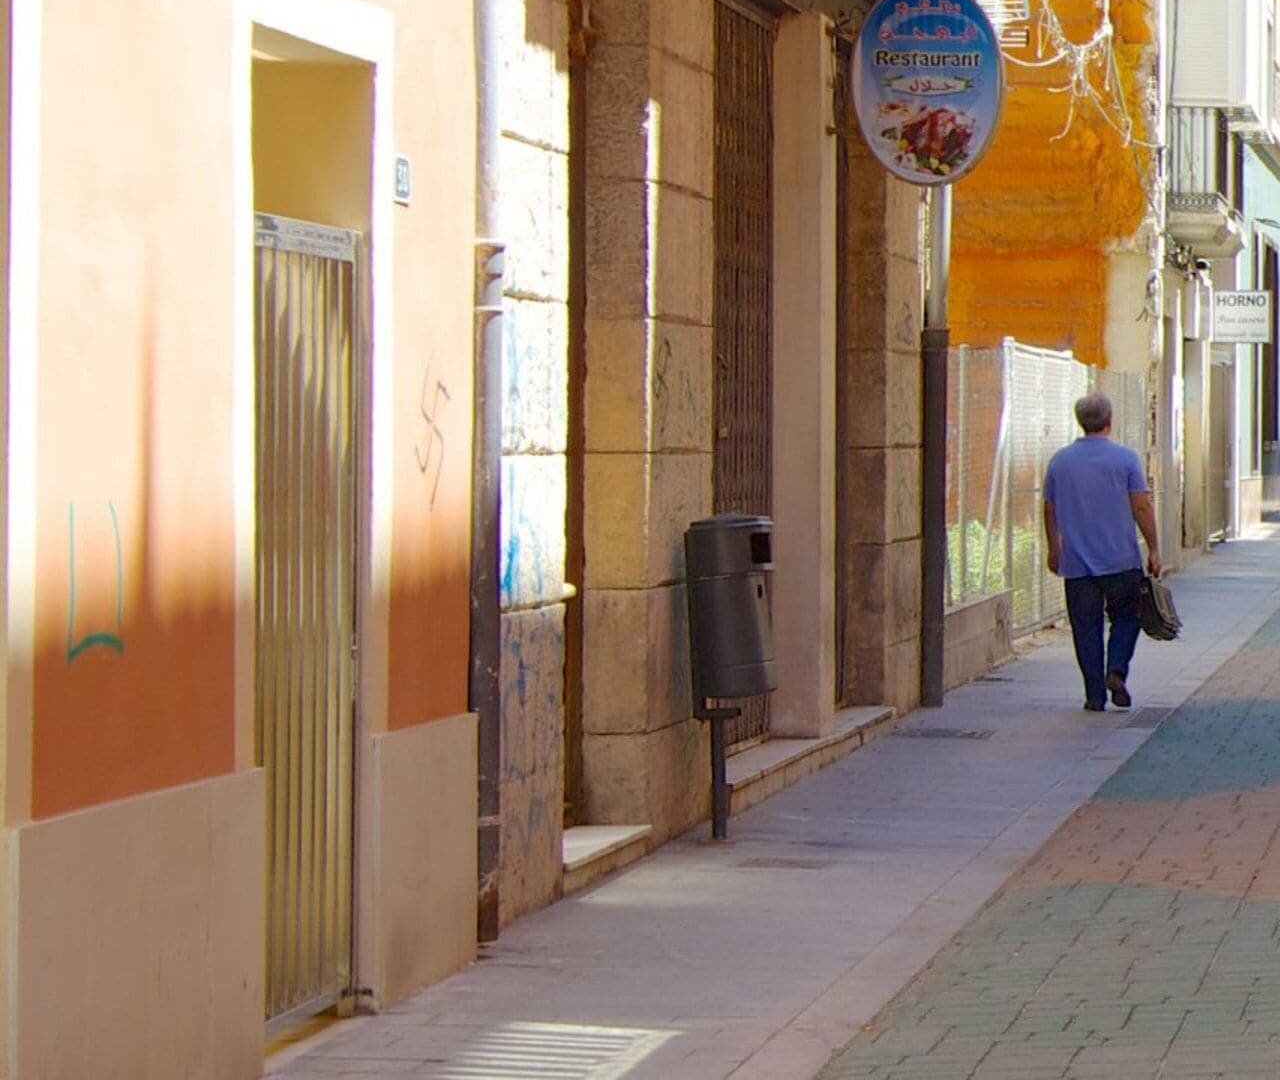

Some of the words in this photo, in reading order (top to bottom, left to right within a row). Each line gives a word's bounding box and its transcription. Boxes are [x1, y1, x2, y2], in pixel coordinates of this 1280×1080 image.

[875, 50, 980, 67] Restaurant
[909, 80, 956, 92] حلال
[1217, 295, 1266, 307] HORNO
